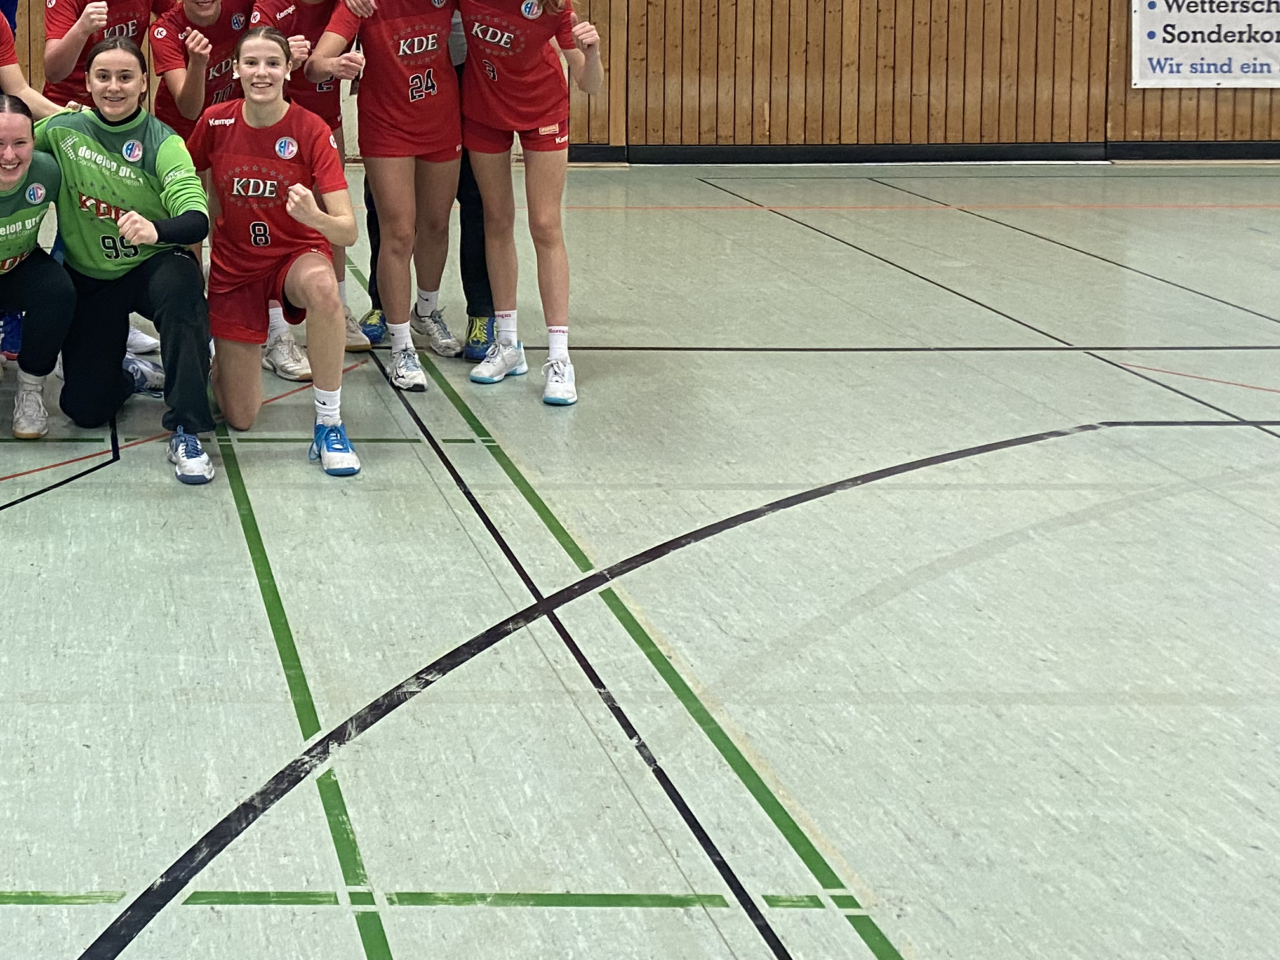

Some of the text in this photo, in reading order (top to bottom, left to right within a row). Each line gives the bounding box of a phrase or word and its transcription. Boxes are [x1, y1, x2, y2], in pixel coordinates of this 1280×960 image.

[398, 33, 438, 56] KDE
[471, 22, 514, 48] KDE
[208, 58, 233, 80] KD
[1148, 57, 1272, 74] Wir sind ein
[409, 68, 437, 102] 24
[232, 178, 278, 198] KDE
[250, 221, 270, 246] 8
